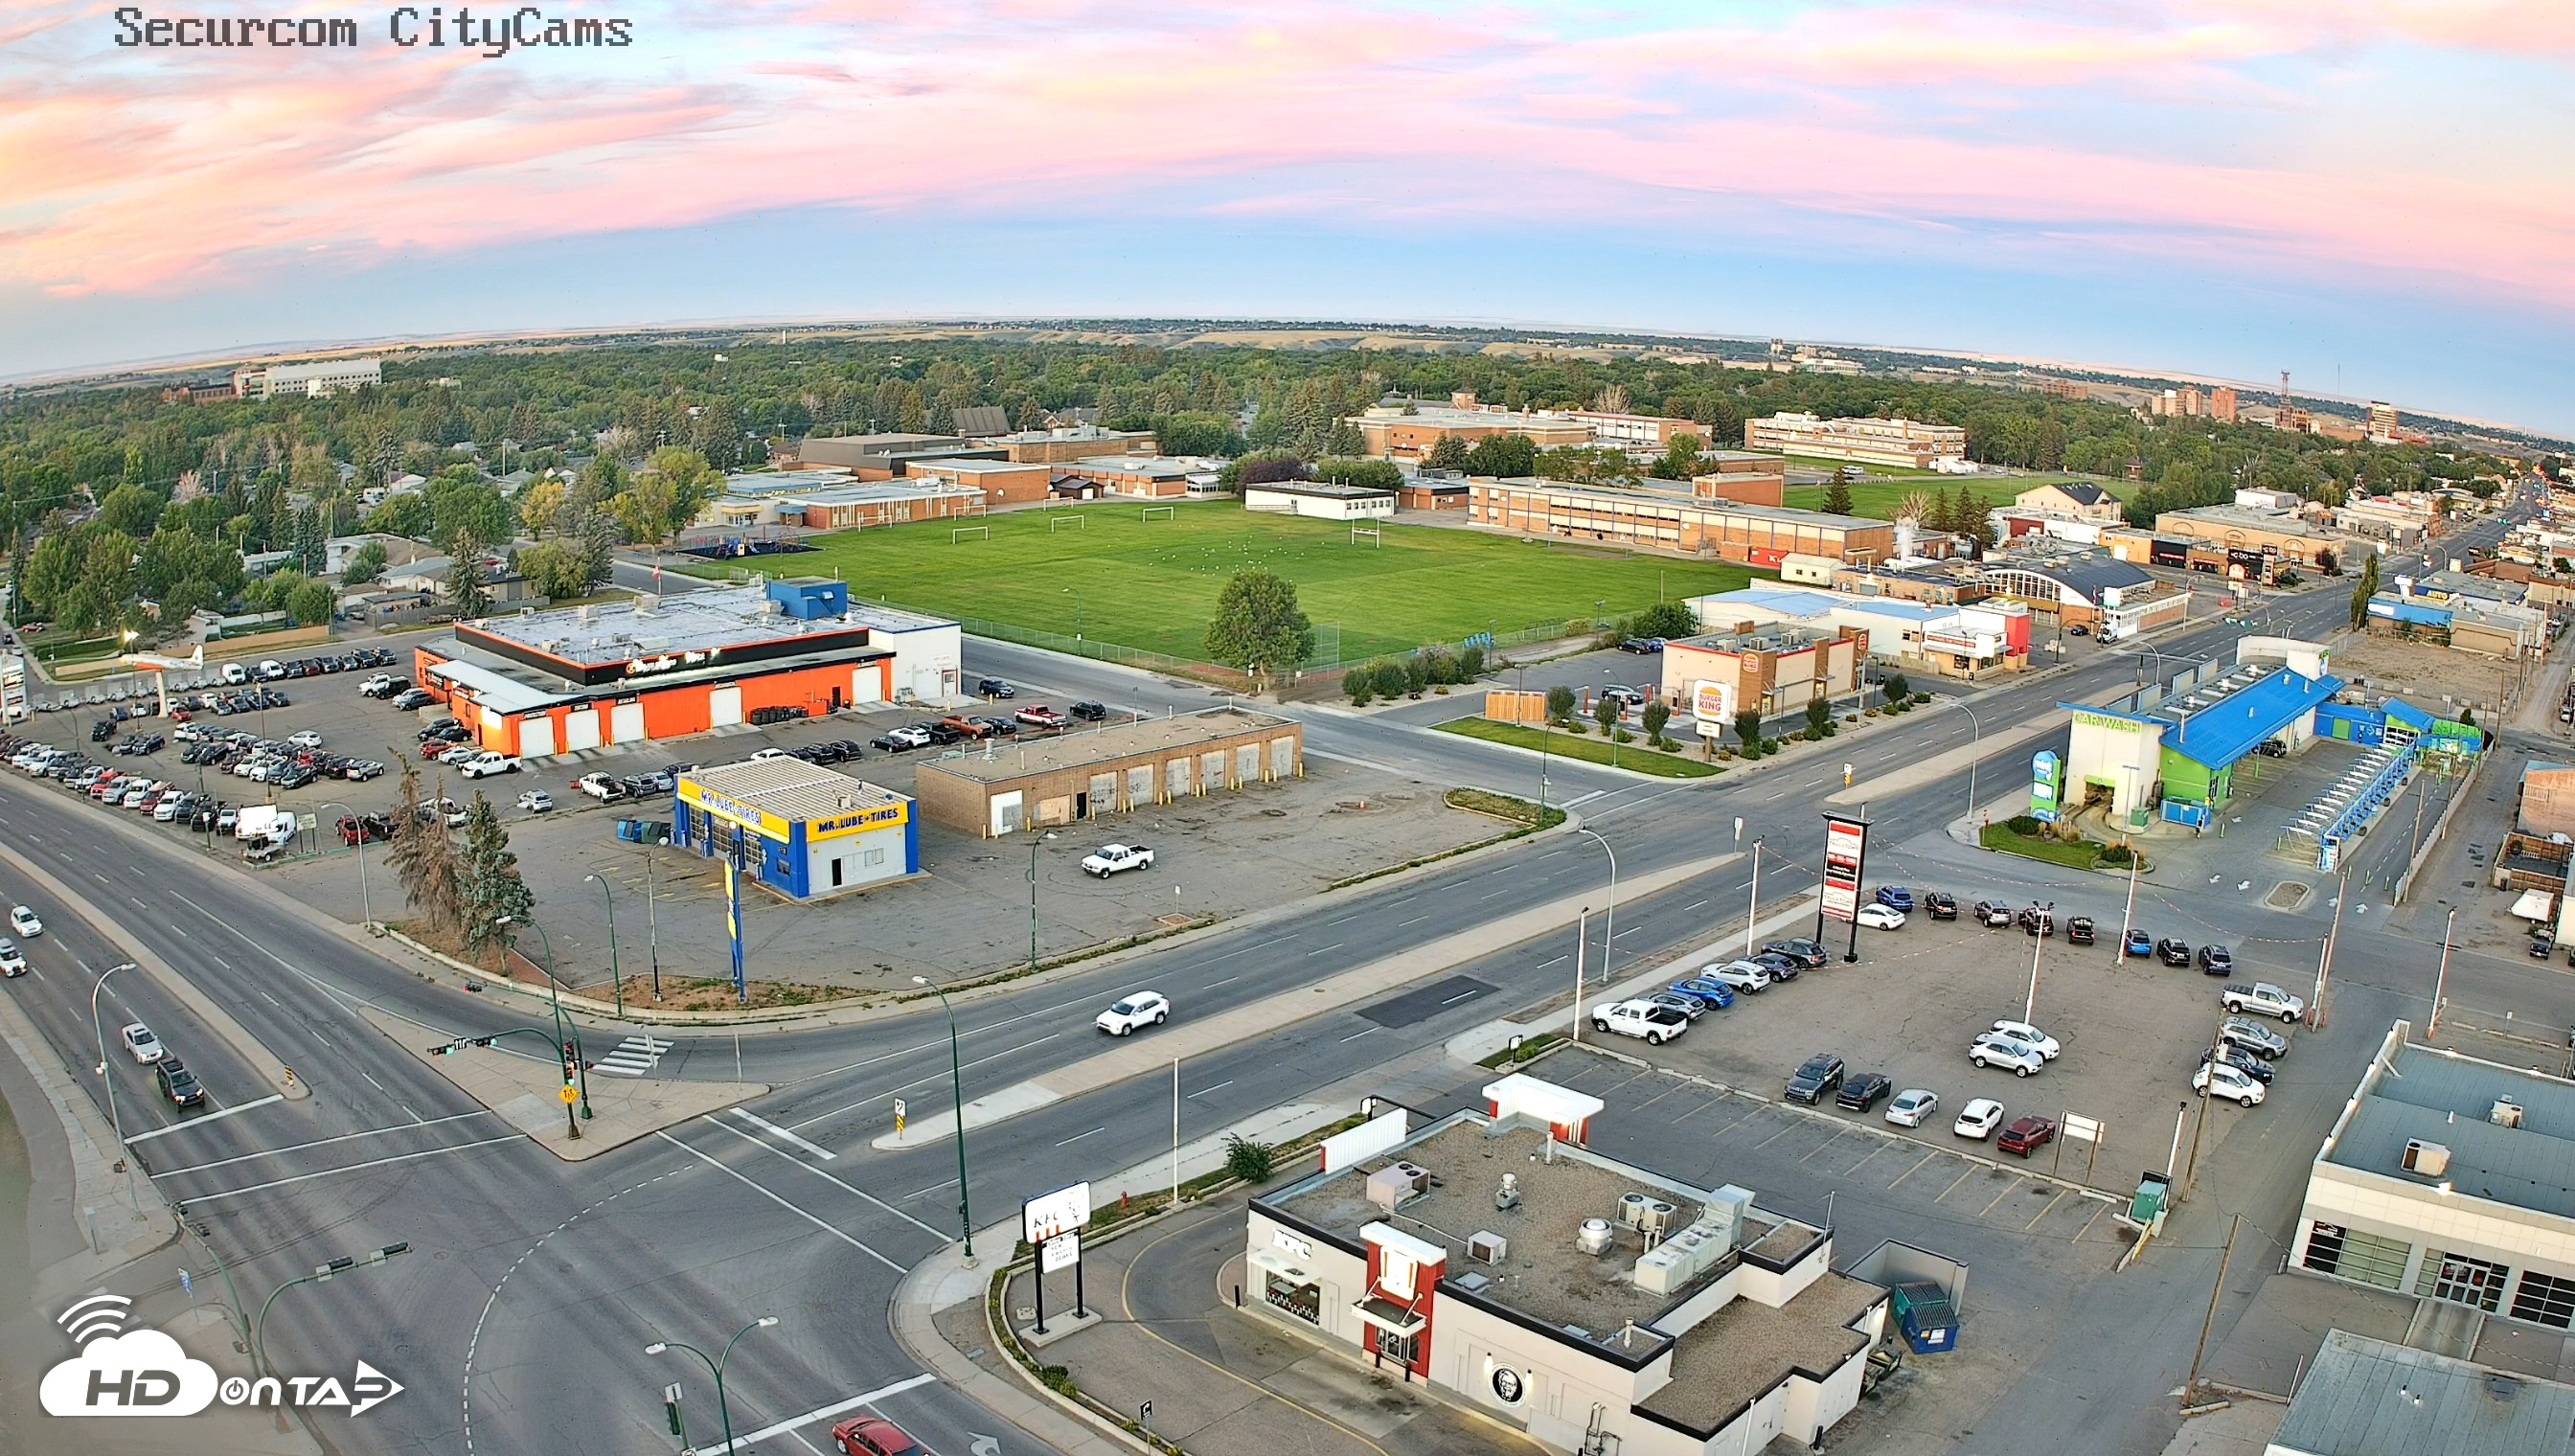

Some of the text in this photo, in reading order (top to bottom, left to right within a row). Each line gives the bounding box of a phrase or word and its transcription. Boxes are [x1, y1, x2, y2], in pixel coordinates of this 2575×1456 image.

[2427, 590, 2449, 600] AUTO
[1698, 700, 1721, 711] KING
[1699, 694, 1722, 703] BURGER
[2075, 713, 2141, 735] CAR WASH
[701, 789, 716, 805] MR.
[716, 796, 735, 813] LUBE
[739, 806, 762, 825] TIRES
[818, 820, 839, 832] MR.
[840, 815, 864, 829] LUBE
[871, 808, 899, 823] TIRES
[1272, 1228, 1313, 1261] KFC
